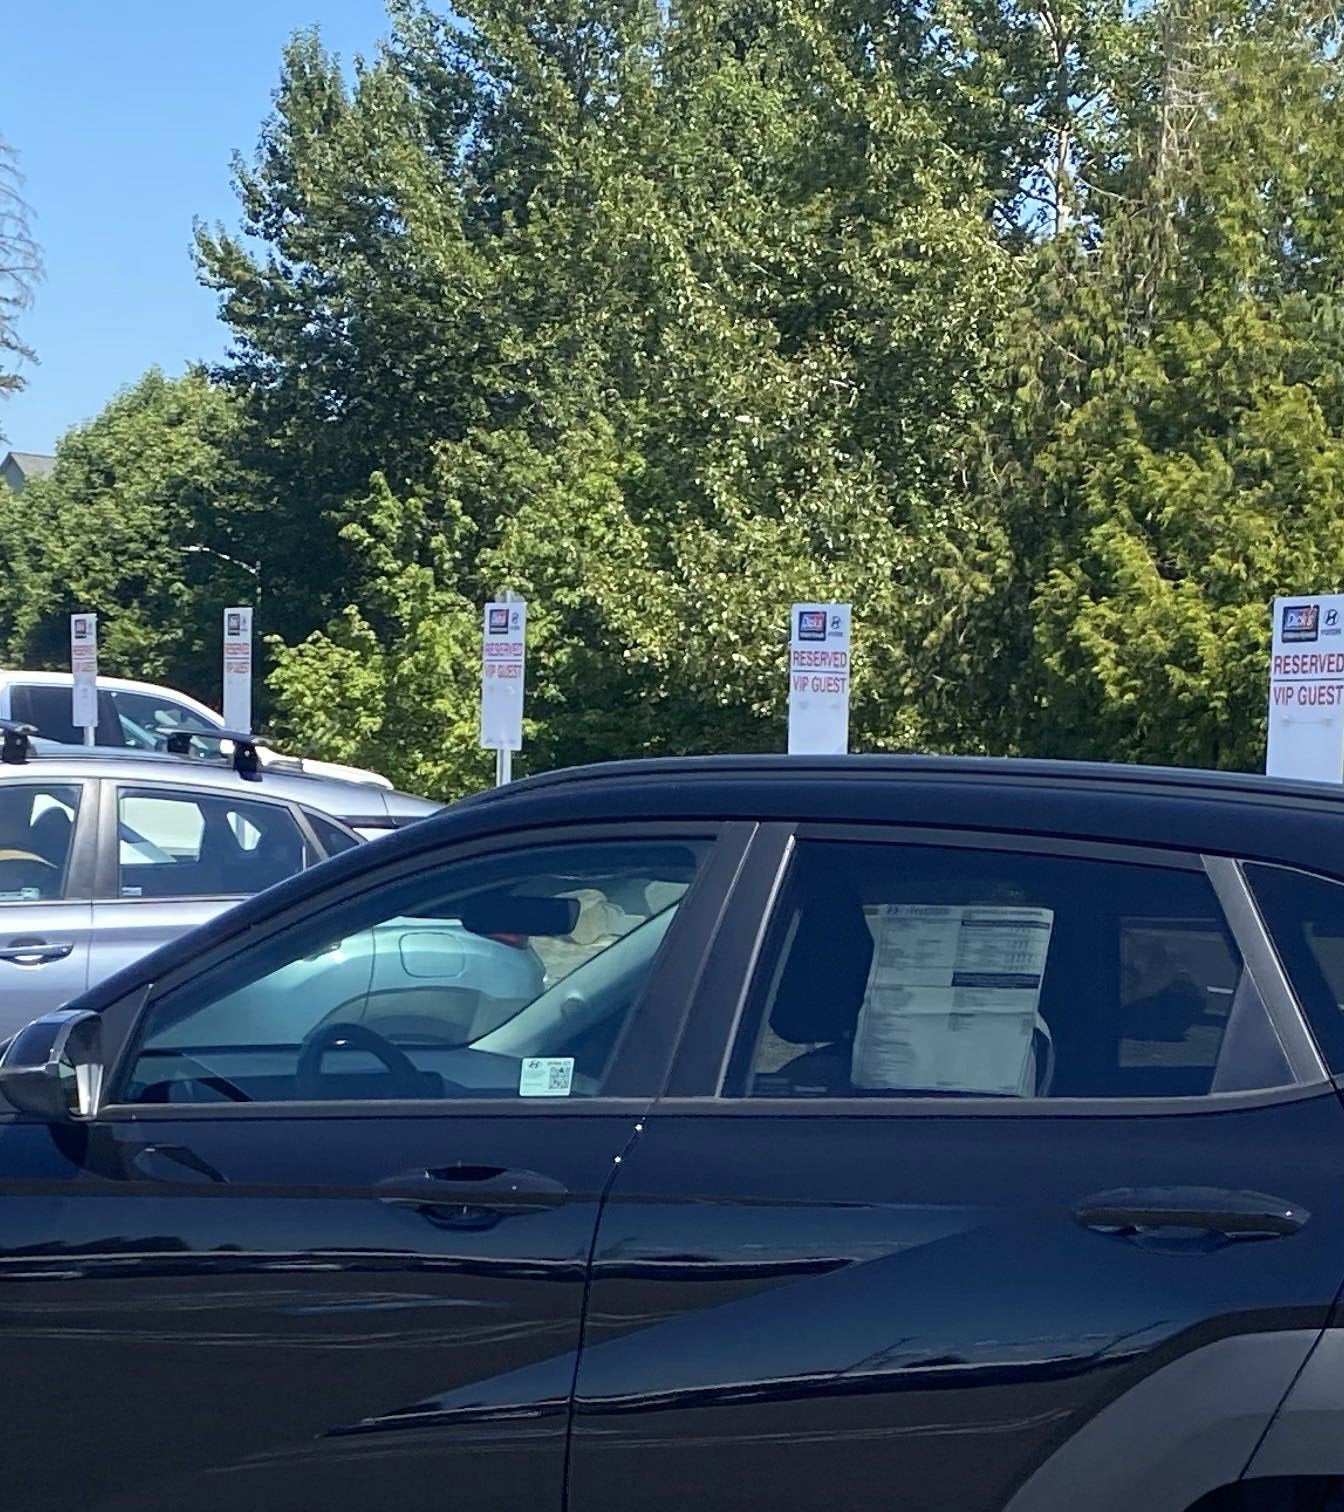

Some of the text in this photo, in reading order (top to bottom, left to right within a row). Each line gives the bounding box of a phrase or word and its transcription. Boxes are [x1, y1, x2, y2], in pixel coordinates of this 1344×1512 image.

[793, 650, 848, 668] RESERVED
[793, 675, 847, 693] VIP GUEST
[1274, 684, 1344, 705] VIP GUEST
